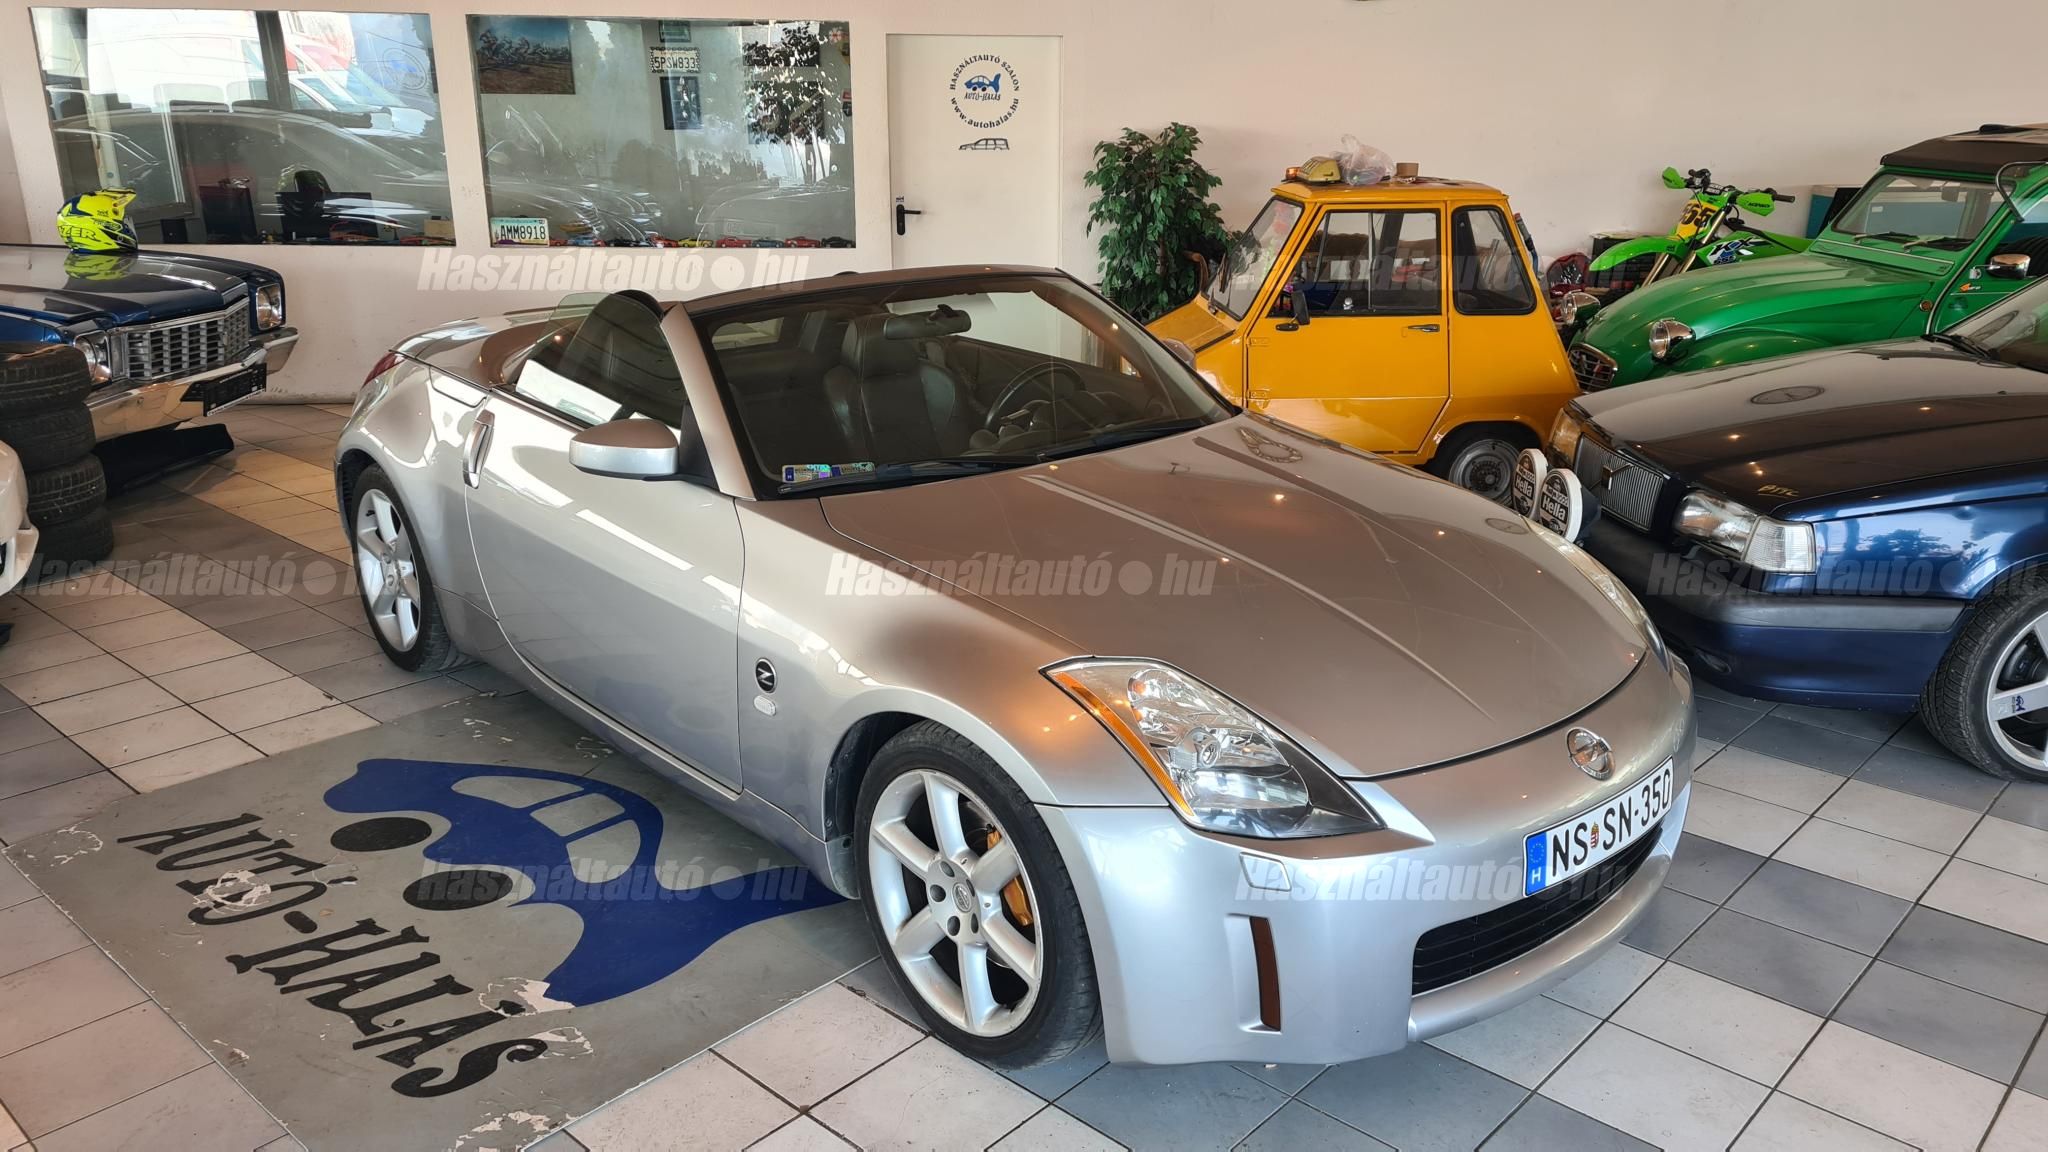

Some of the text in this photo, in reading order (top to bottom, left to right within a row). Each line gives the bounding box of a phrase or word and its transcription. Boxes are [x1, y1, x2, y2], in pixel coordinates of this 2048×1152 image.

[653, 56, 697, 69] 5PSW833
[1000, 61, 1020, 92] SZALON
[951, 96, 1020, 129] www.autohalas.hu
[500, 224, 547, 240] AMM8918
[1515, 475, 1533, 498] Hella
[1542, 495, 1566, 520] Hella
